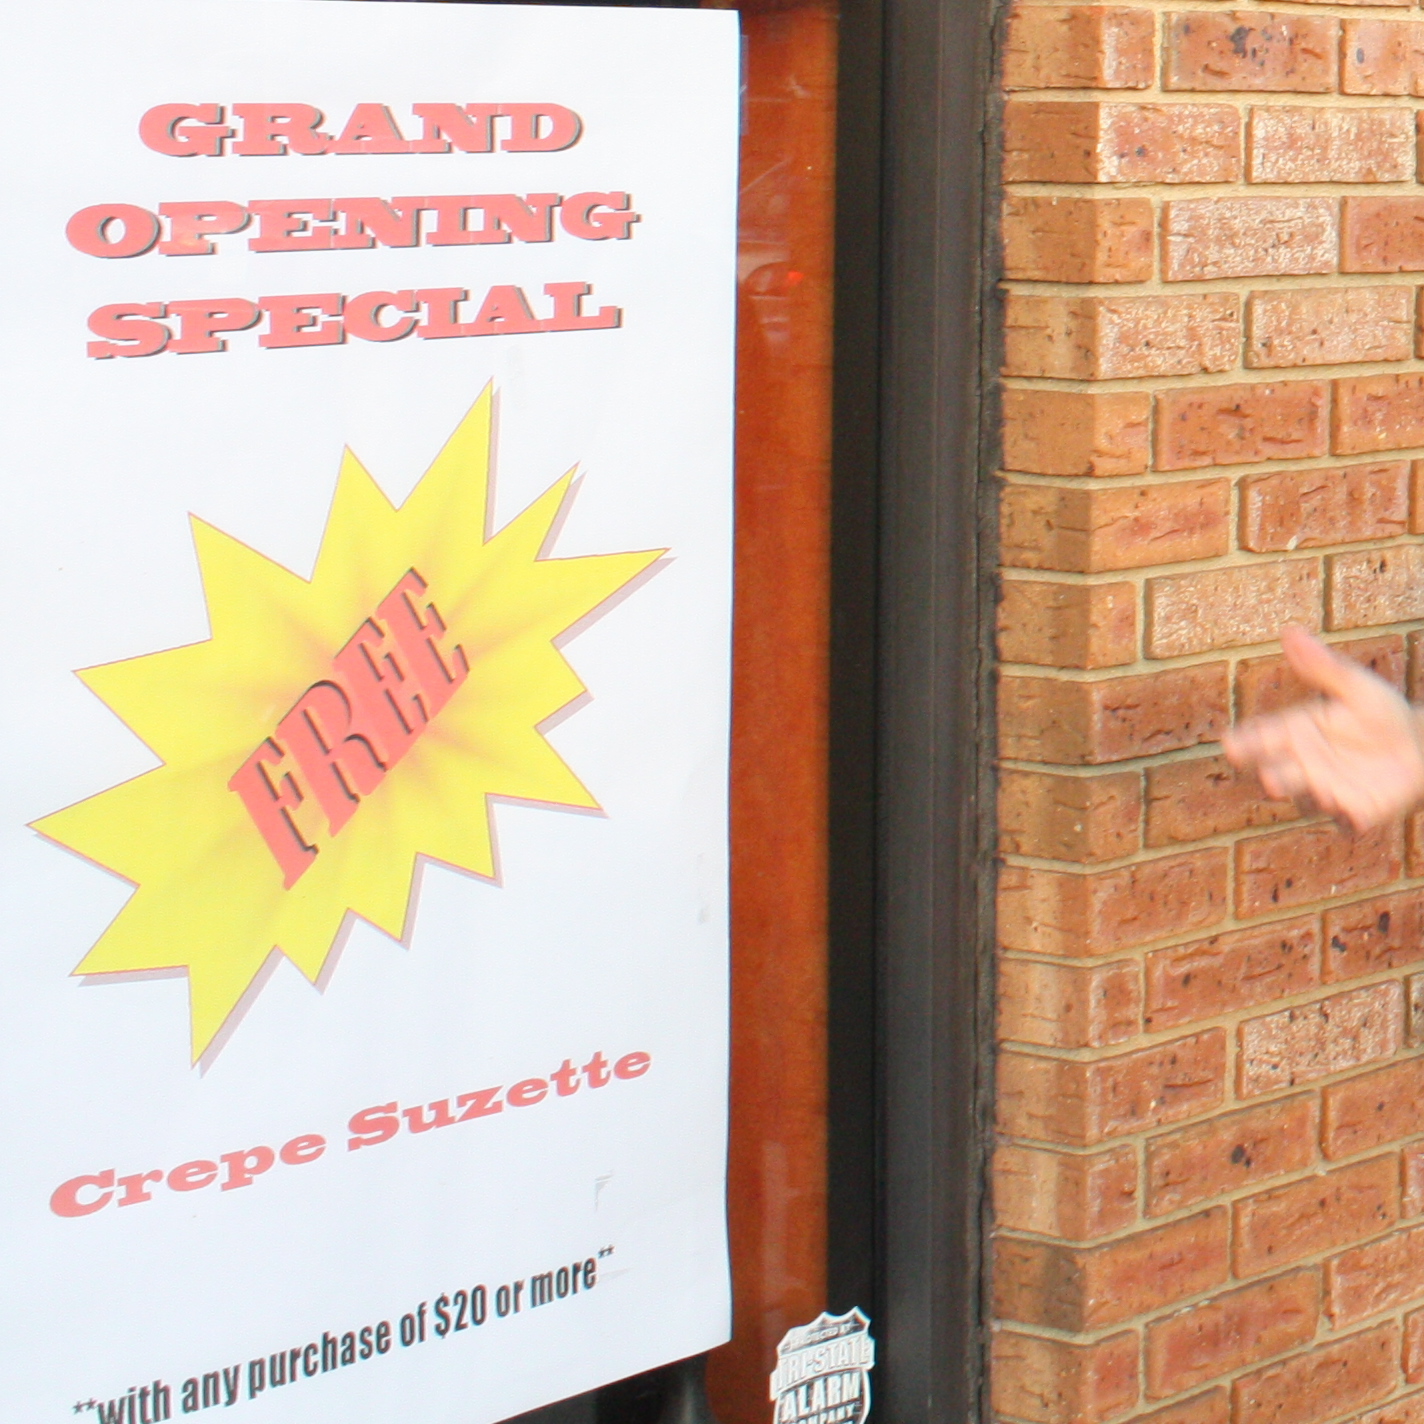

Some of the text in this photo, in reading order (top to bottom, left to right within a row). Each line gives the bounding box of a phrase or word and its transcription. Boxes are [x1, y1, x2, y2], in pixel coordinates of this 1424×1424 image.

[139, 102, 583, 157] GRAND
[65, 191, 641, 259] OPENING
[86, 281, 622, 359] SPECIAL
[227, 566, 470, 891] FREE
[49, 1050, 653, 1218] Crepe Suzette
[181, 1362, 242, 1414] any
[248, 1318, 392, 1399] purchase
[400, 1301, 428, 1348] of
[433, 1283, 488, 1340] $20
[496, 1278, 525, 1318] or
[781, 1372, 860, 1422] ALARM
